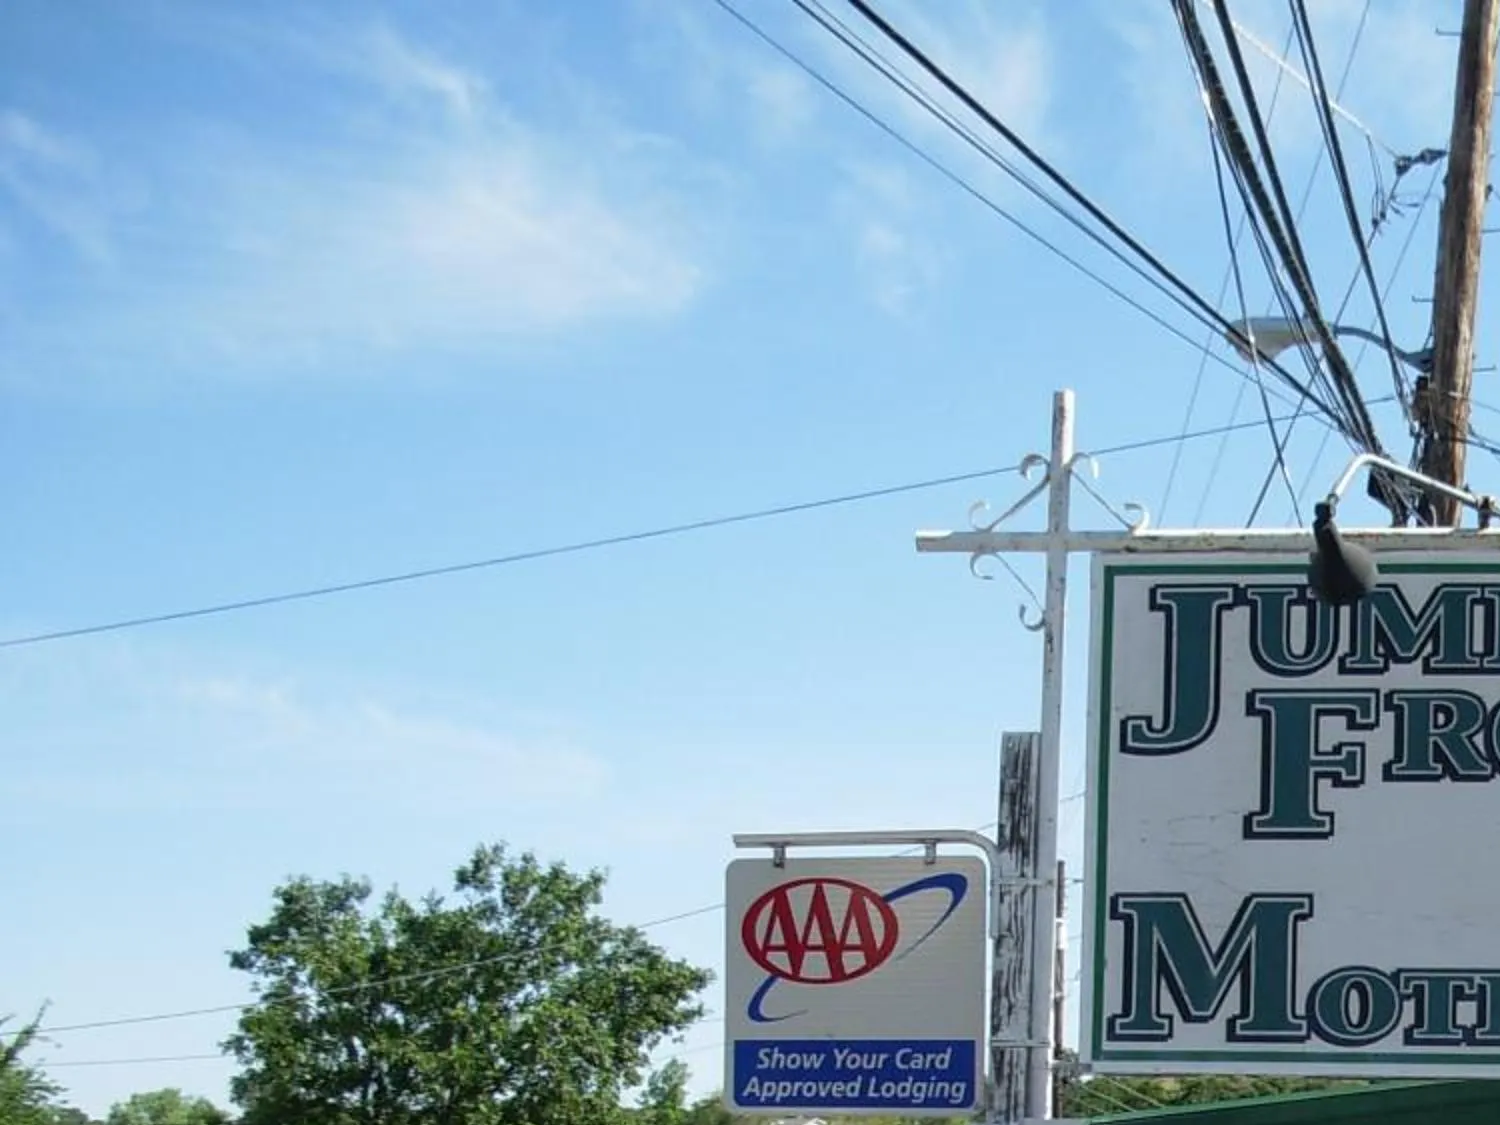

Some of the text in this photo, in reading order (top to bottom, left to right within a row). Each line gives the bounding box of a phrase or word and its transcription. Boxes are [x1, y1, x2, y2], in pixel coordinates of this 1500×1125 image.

[757, 879, 884, 981] AAA
[756, 1048, 952, 1070] Show Your Card
[742, 1076, 966, 1104] Approved Lodging
